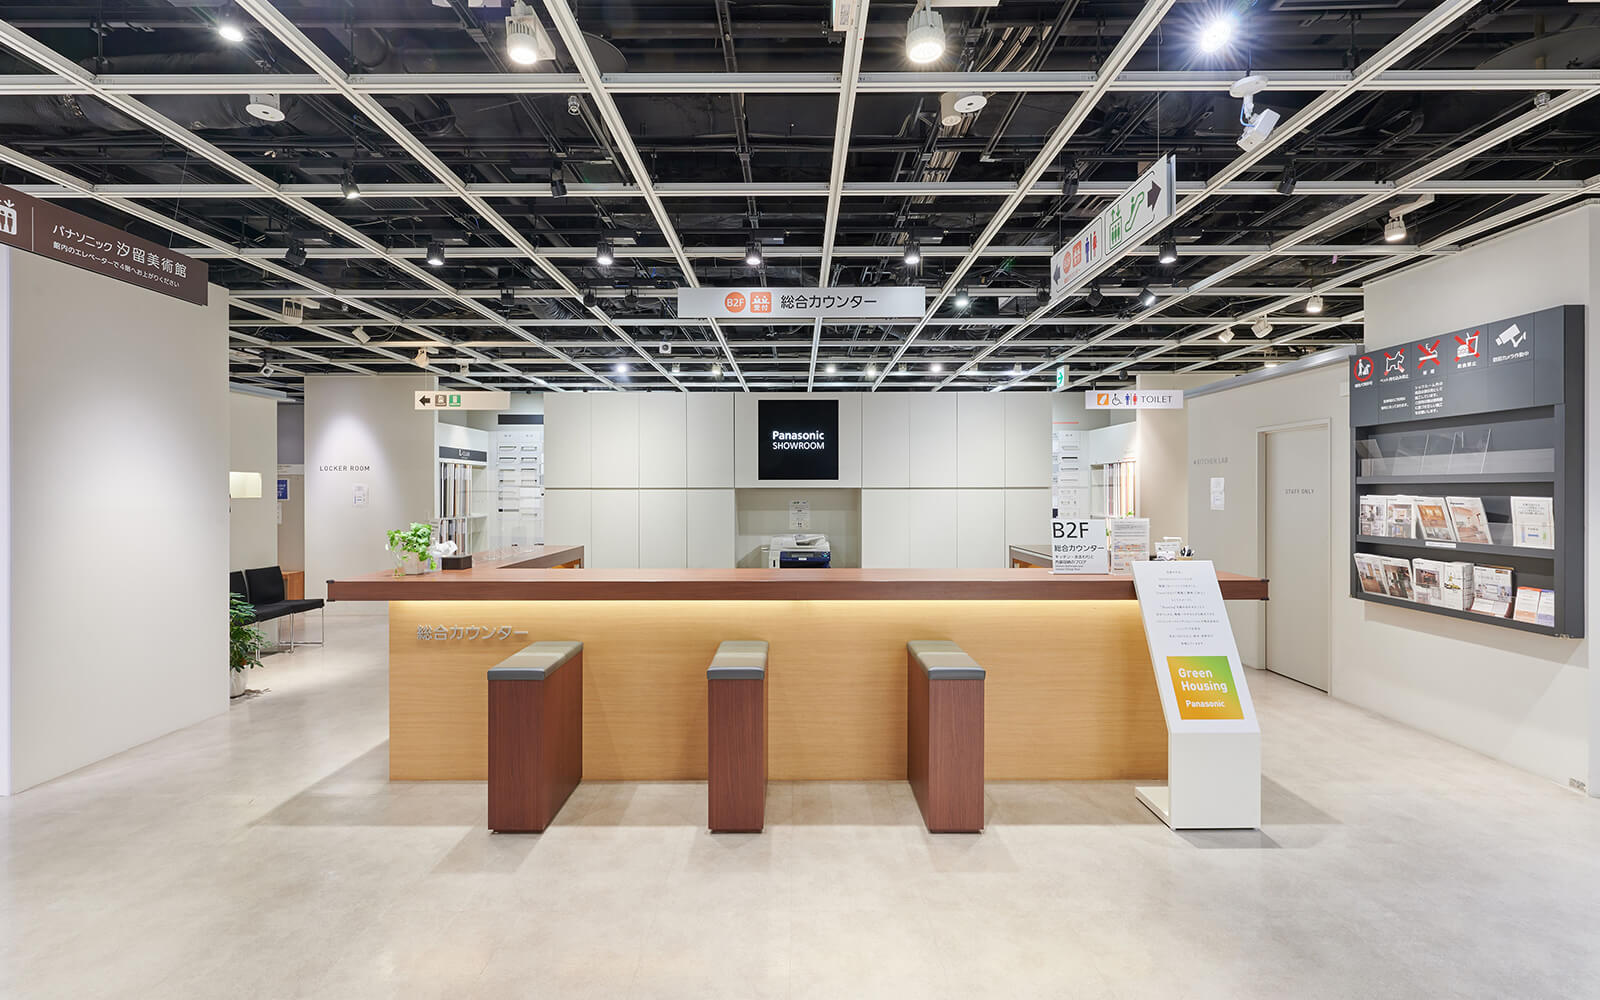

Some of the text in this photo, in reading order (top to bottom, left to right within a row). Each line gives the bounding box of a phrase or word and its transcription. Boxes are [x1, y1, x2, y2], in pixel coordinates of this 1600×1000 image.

[53, 225, 187, 279] パナソニック 汐留美術館
[727, 298, 745, 308] B2F
[780, 294, 877, 310] 総合カウンター
[1141, 395, 1172, 404] TOILET
[772, 430, 825, 440] Panasonic
[772, 441, 825, 450] SHOWROOM
[1052, 521, 1089, 539] B2F
[1054, 544, 1105, 553] 総合カウンター
[416, 624, 529, 641] 総合カウンター
[1178, 667, 1213, 679] Green
[1181, 680, 1228, 693] Housing
[1185, 699, 1225, 708] Panasonic
